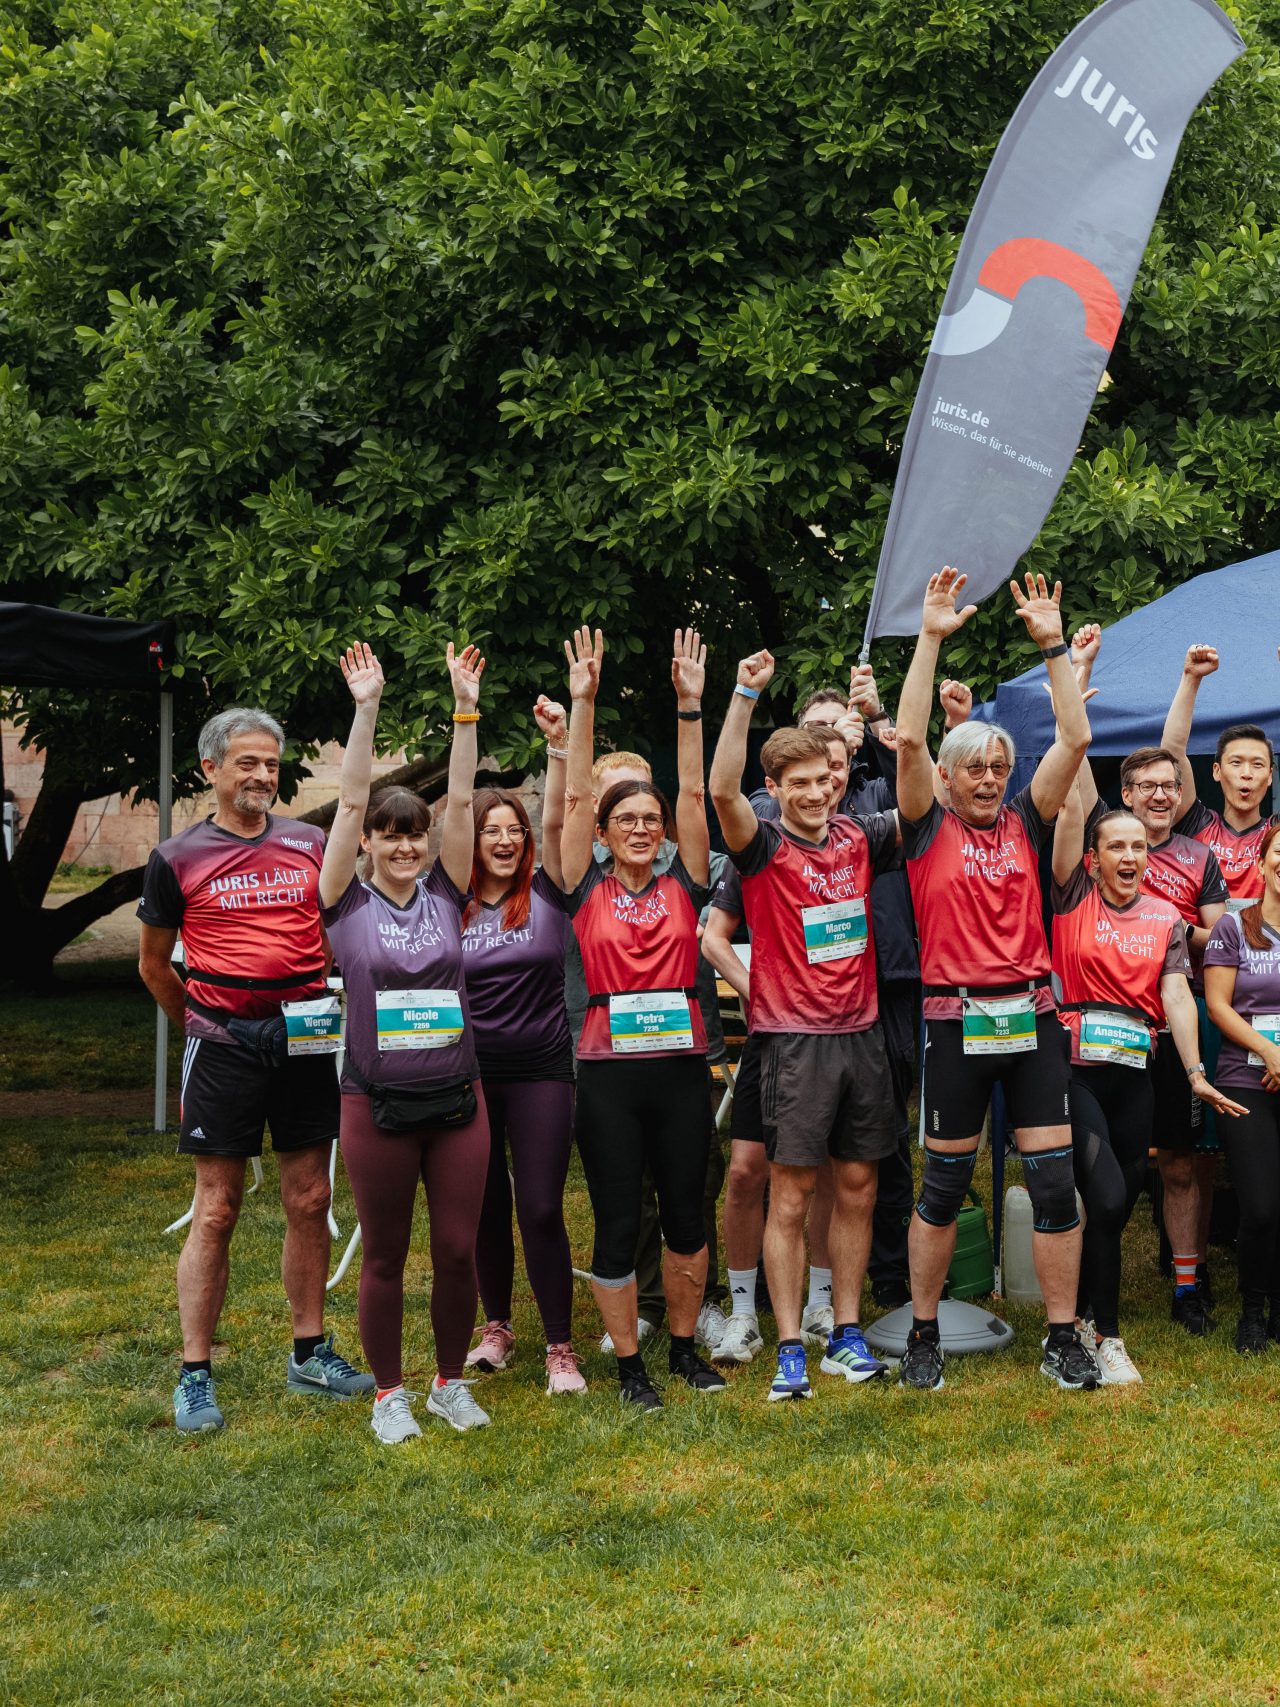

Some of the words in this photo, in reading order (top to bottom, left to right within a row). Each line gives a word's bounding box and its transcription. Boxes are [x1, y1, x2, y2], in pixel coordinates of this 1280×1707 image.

[1054, 56, 1158, 160] juris
[933, 397, 989, 428] juris.de
[931, 416, 967, 438] Wissen,
[970, 430, 987, 444] das
[989, 437, 1002, 451] für
[1003, 445, 1017, 459] Sie
[1017, 456, 1053, 478] arbeitet.
[281, 836, 313, 850] Werner
[209, 873, 260, 895] JURIS
[264, 868, 310, 886] LÄUFT
[220, 892, 251, 911] MIT
[256, 887, 308, 905] RECHT.
[825, 921, 852, 934] Marco
[381, 937, 406, 951] MIT
[486, 929, 533, 948] RECHT.
[1124, 934, 1157, 947] LÄUFT
[1116, 941, 1154, 959] RECHT.
[1250, 963, 1273, 974] MIT
[304, 1017, 332, 1028] Werner
[403, 1010, 439, 1022] Nicole
[636, 1014, 665, 1024] Petra
[995, 1017, 1008, 1028] Uli
[1094, 1026, 1140, 1042] Anastasia
